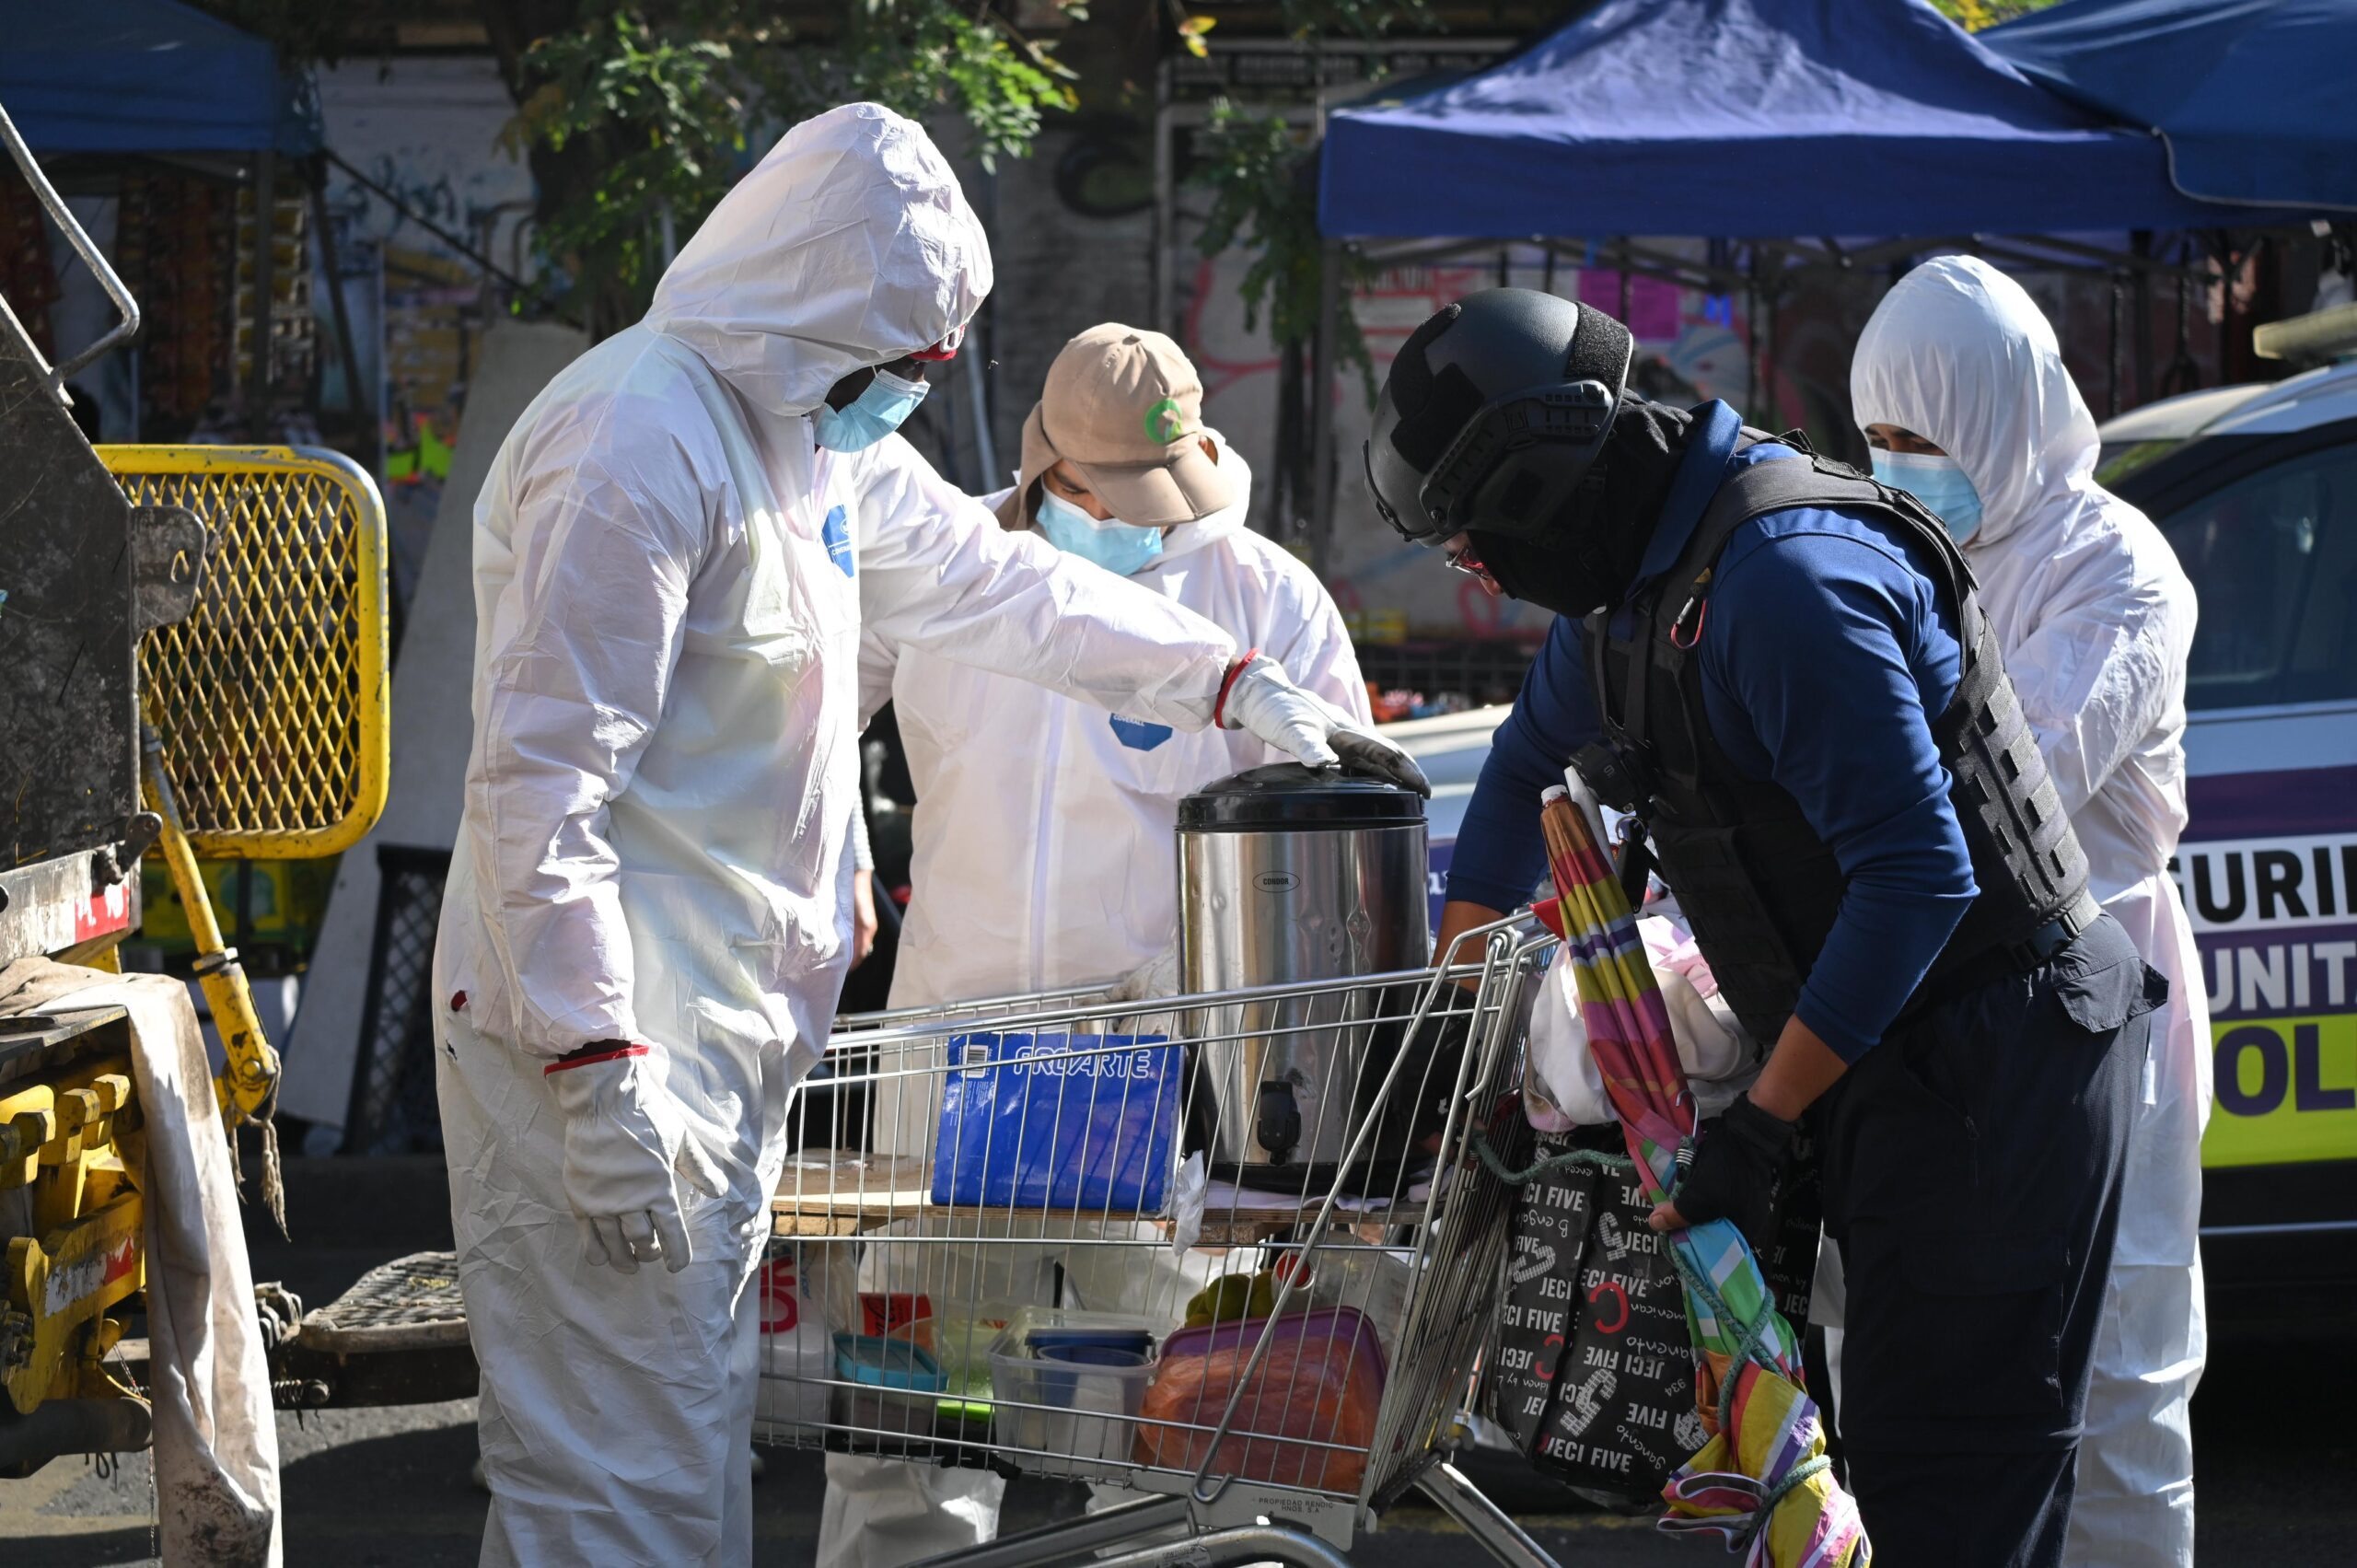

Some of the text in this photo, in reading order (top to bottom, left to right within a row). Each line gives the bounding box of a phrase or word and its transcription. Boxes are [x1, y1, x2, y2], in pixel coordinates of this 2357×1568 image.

[2197, 941, 2357, 1013] UNIT
[1545, 1185, 1585, 1212] FIVE
[1623, 1230, 1658, 1255] JECI
[1538, 1277, 1573, 1300] JECI
[1611, 1272, 1651, 1298] FIVE
[1526, 1307, 1563, 1333] FIVE
[1583, 1346, 1666, 1379] JECI FIVE
[1665, 1378, 1687, 1398] 934
[1625, 1402, 1668, 1429] FIVE
[1544, 1436, 1633, 1473] JECI FIVE
[1259, 1497, 1303, 1507] PROPIEDAD
